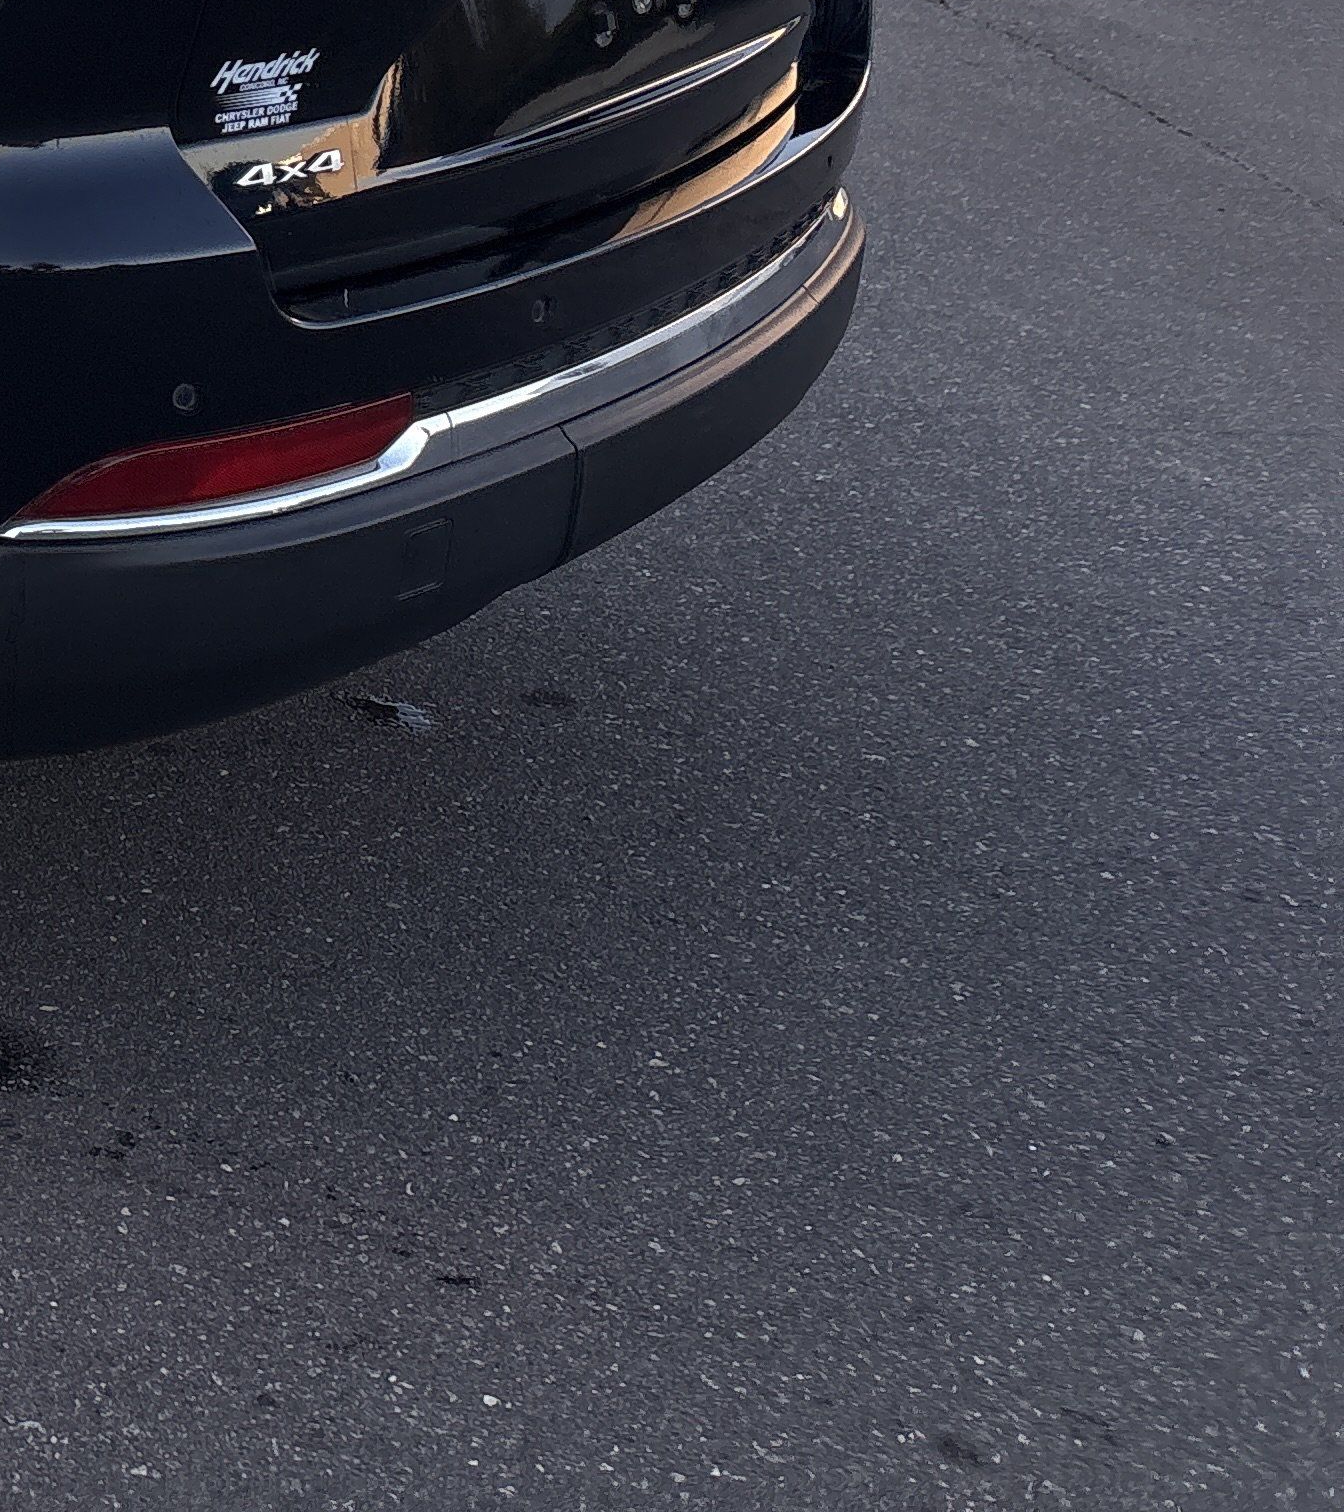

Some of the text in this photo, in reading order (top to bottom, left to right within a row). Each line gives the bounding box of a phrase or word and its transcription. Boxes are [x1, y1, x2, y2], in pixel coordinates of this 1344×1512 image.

[210, 48, 320, 94] Hendrick
[214, 101, 298, 124] CHRYSLER DODGE
[221, 113, 292, 134] JEEP RAM FIAT
[235, 149, 344, 187] 4x4
